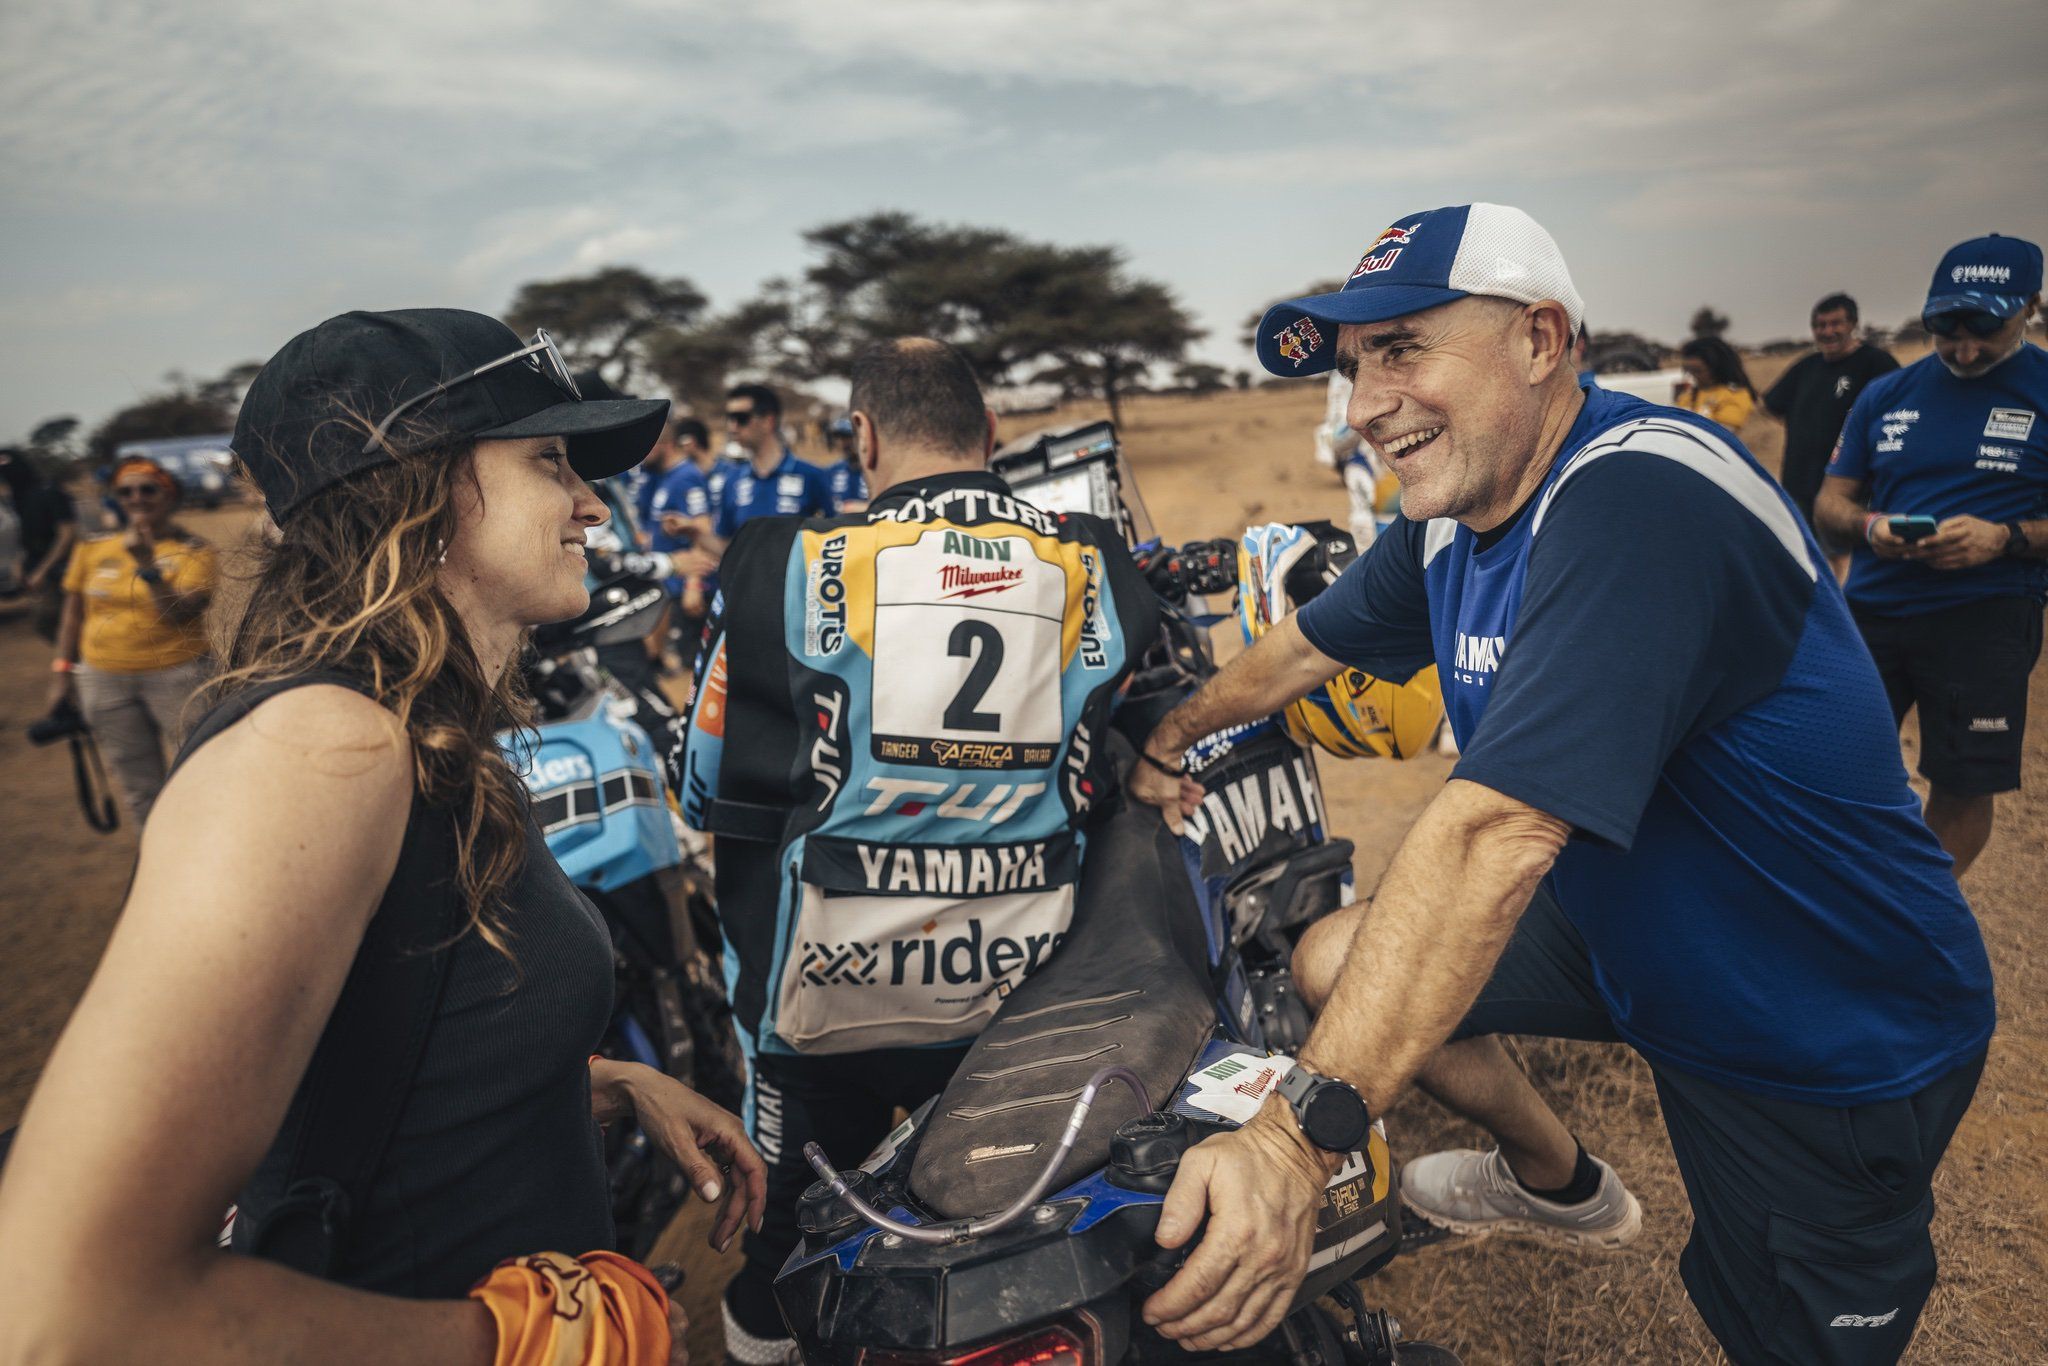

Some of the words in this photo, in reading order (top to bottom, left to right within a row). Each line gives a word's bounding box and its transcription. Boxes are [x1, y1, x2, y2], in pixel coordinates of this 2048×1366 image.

[1352, 248, 1402, 279] Bull
[1964, 264, 2011, 281] YAMAHA
[938, 564, 1023, 590] Milwaukee
[942, 619, 1005, 733] 2
[881, 741, 919, 760] TANGER
[942, 743, 1014, 761] AFRICA
[857, 842, 1047, 894] YAMAHA
[1233, 1066, 1277, 1100] Milwaukee
